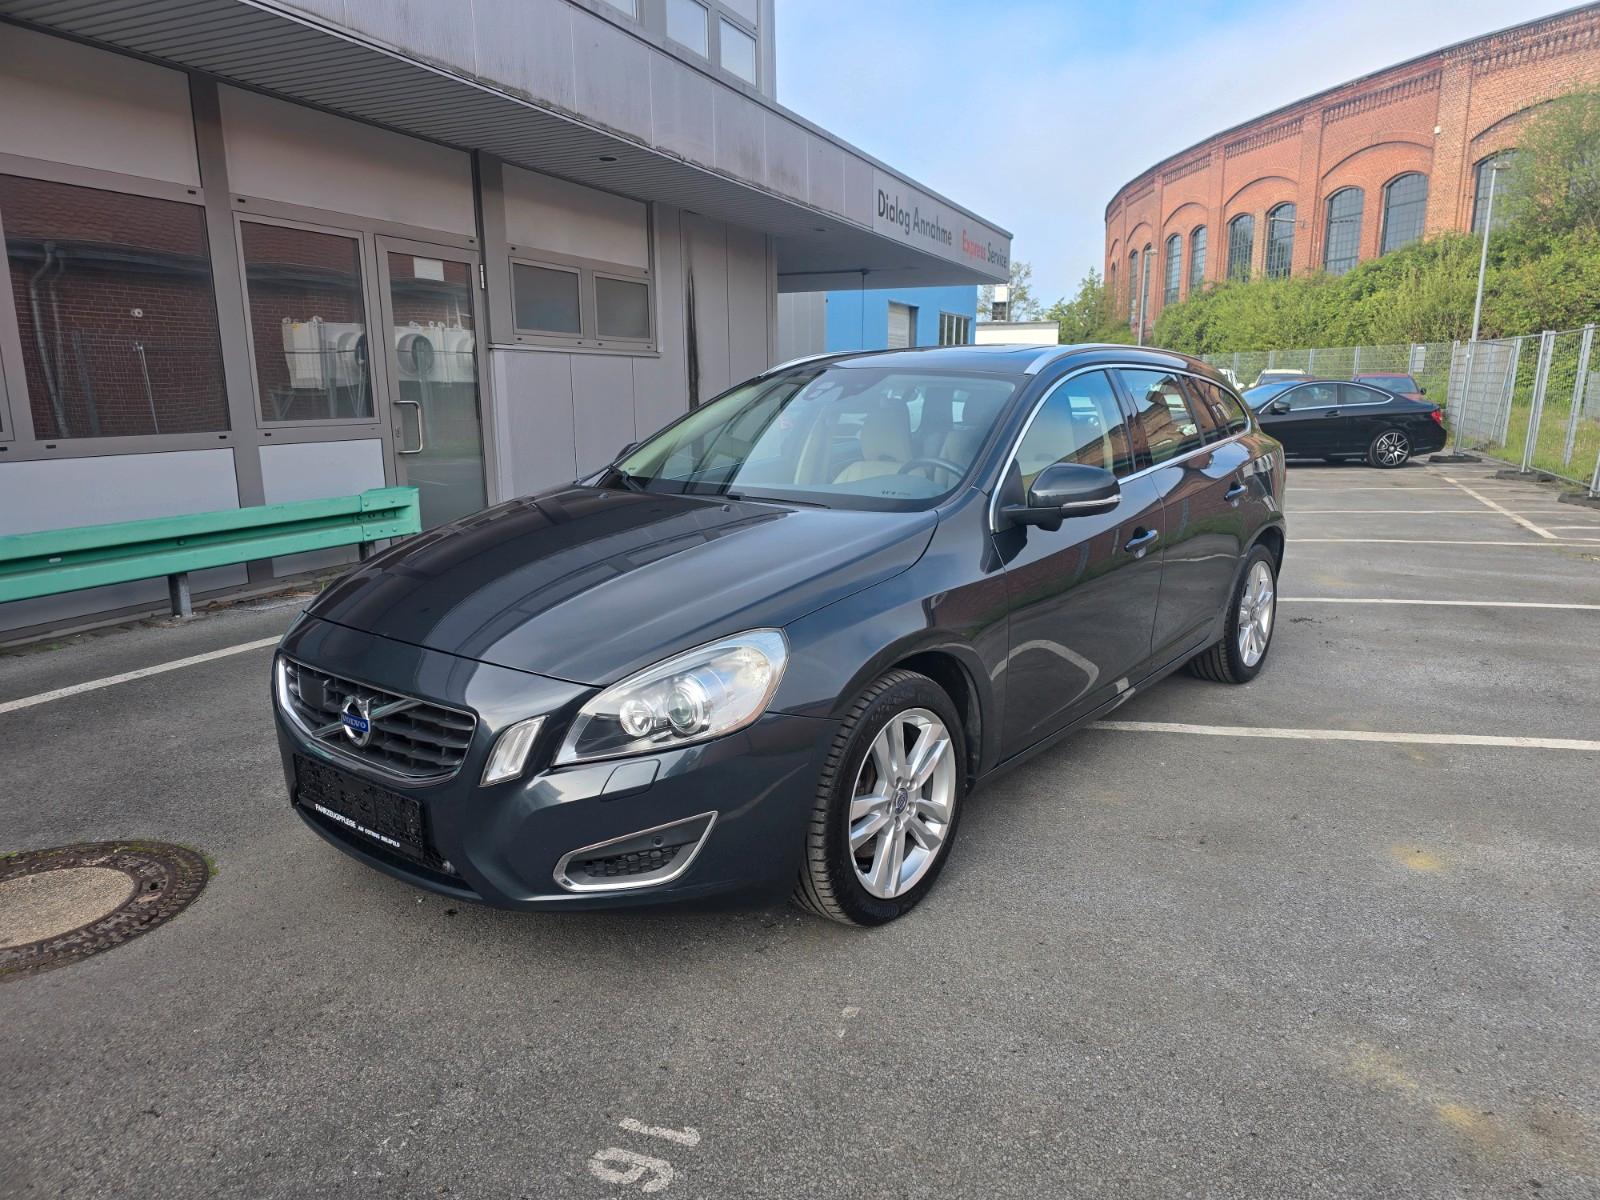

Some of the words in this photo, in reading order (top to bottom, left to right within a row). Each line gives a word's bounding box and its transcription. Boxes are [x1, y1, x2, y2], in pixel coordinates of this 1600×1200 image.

[878, 189, 910, 235] Dialog
[913, 207, 952, 246] Annahme
[987, 241, 1007, 269] Service
[341, 713, 368, 729] VOLVO
[587, 1117, 701, 1193] 16
